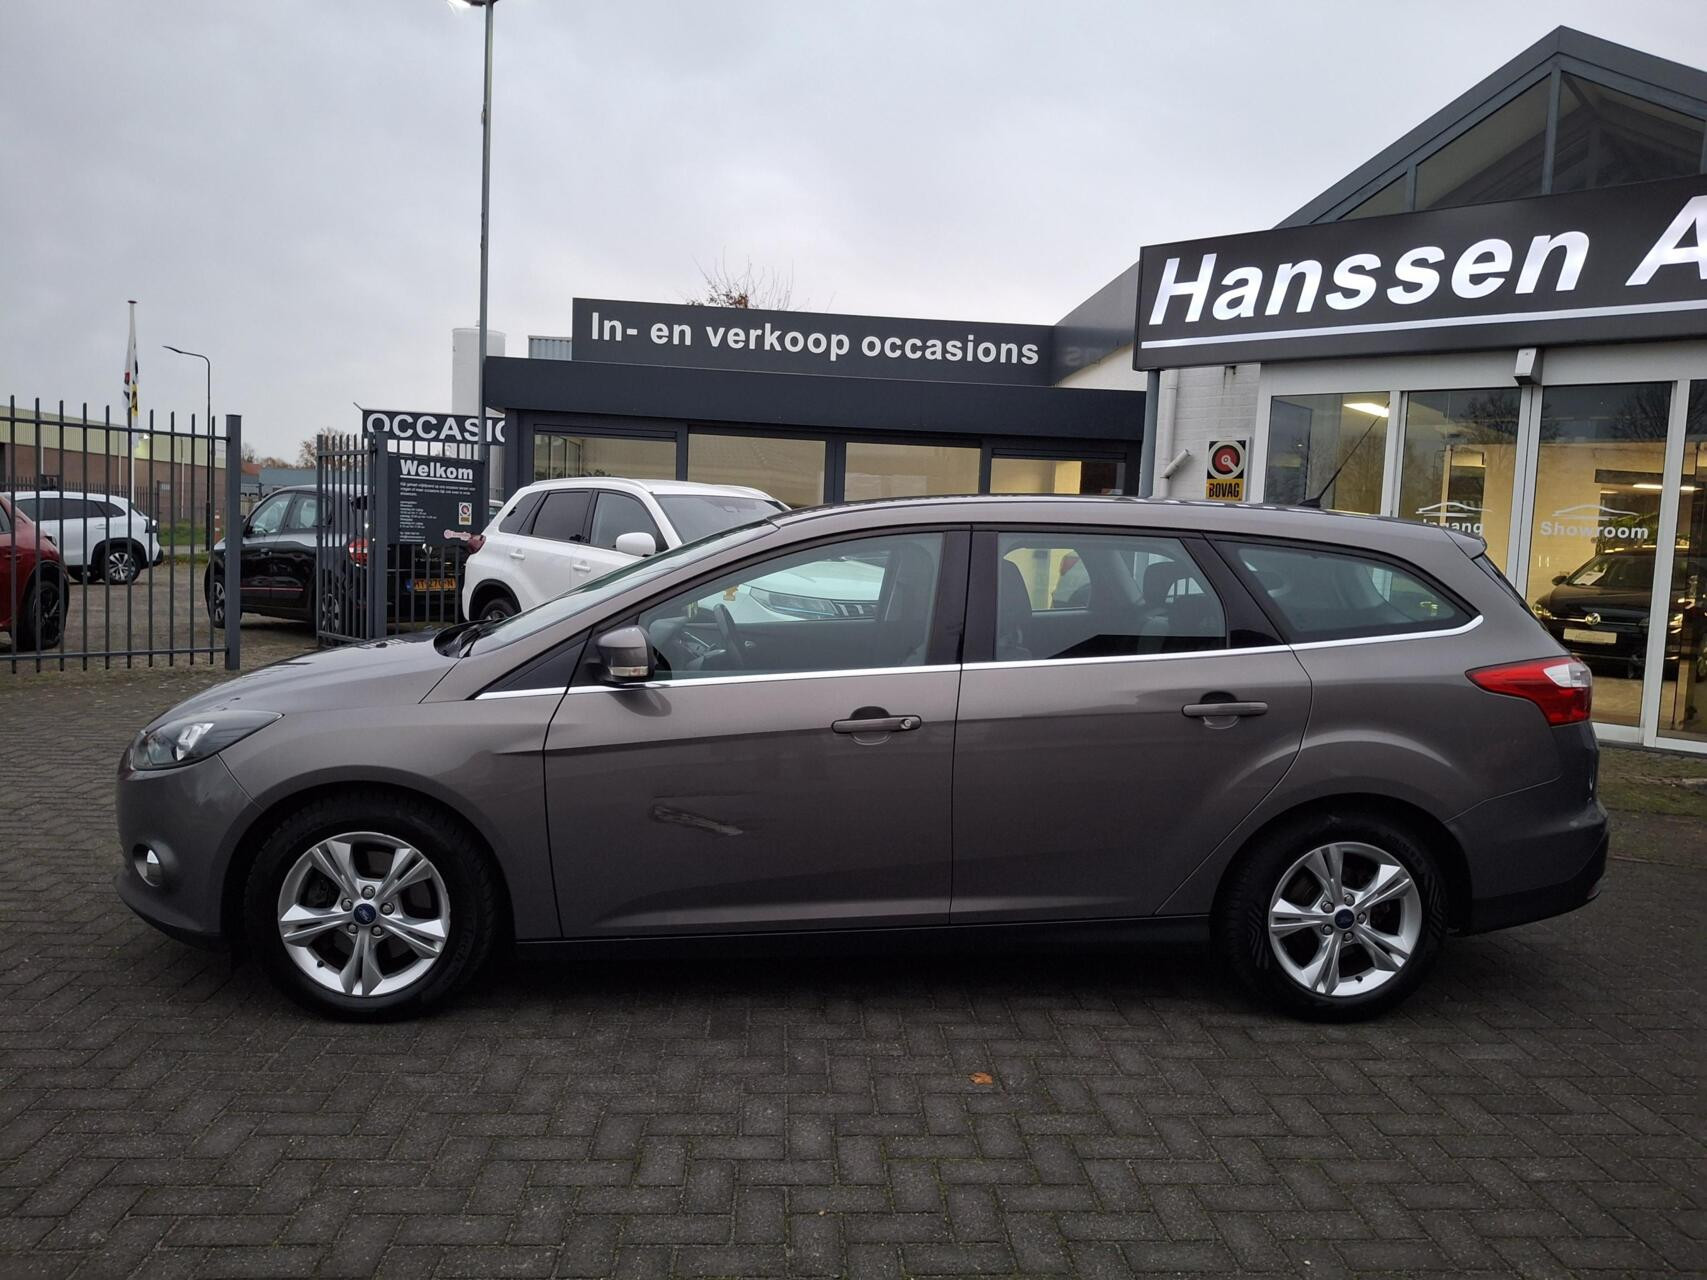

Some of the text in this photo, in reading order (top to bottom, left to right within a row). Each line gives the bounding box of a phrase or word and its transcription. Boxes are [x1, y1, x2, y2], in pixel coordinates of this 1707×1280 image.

[1149, 231, 1590, 326] Hanssen
[591, 312, 638, 342] In-
[650, 322, 692, 346] en
[706, 321, 850, 362] verkoop
[861, 334, 1039, 364] occasions
[399, 458, 473, 480] Welkom
[1208, 482, 1240, 499] BOVAG
[1541, 520, 1649, 540] Showroom
